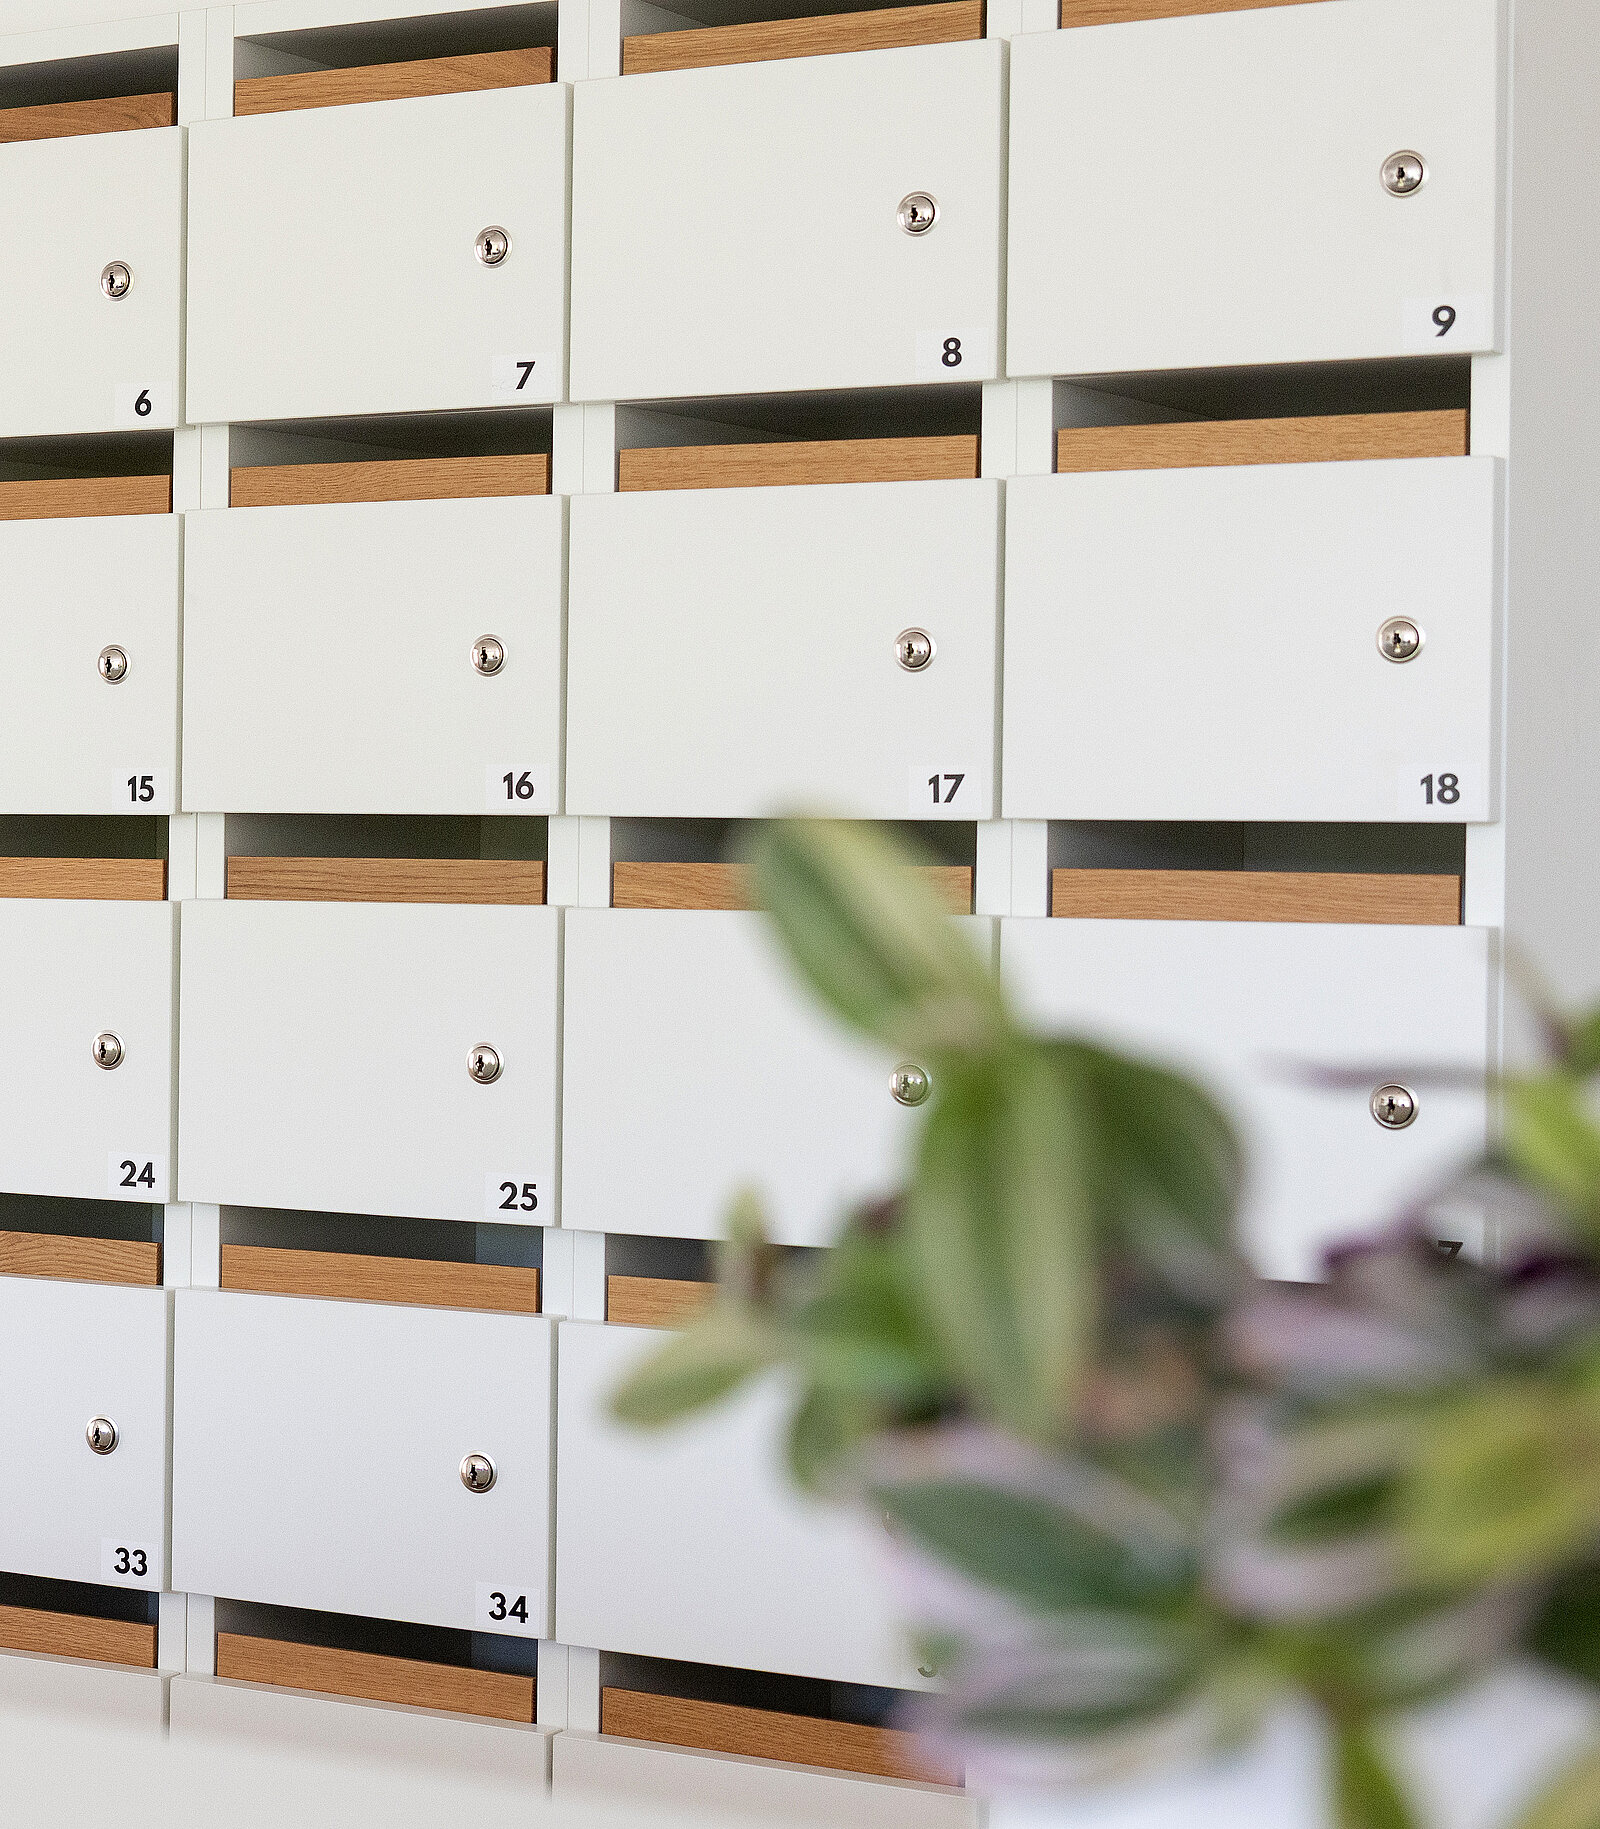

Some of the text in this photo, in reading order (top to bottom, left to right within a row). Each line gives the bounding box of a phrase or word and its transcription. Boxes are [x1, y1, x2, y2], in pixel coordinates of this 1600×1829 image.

[1431, 305, 1457, 337] 9
[941, 337, 963, 368] 8
[515, 360, 536, 390] 7
[134, 389, 152, 417] 6
[127, 775, 155, 803] 15
[502, 771, 535, 800] 16
[928, 773, 966, 804] 17
[1419, 773, 1461, 805] 18
[119, 1159, 156, 1189] 24
[498, 1181, 538, 1212] 25
[113, 1547, 148, 1577] 33
[488, 1591, 529, 1624] 34
